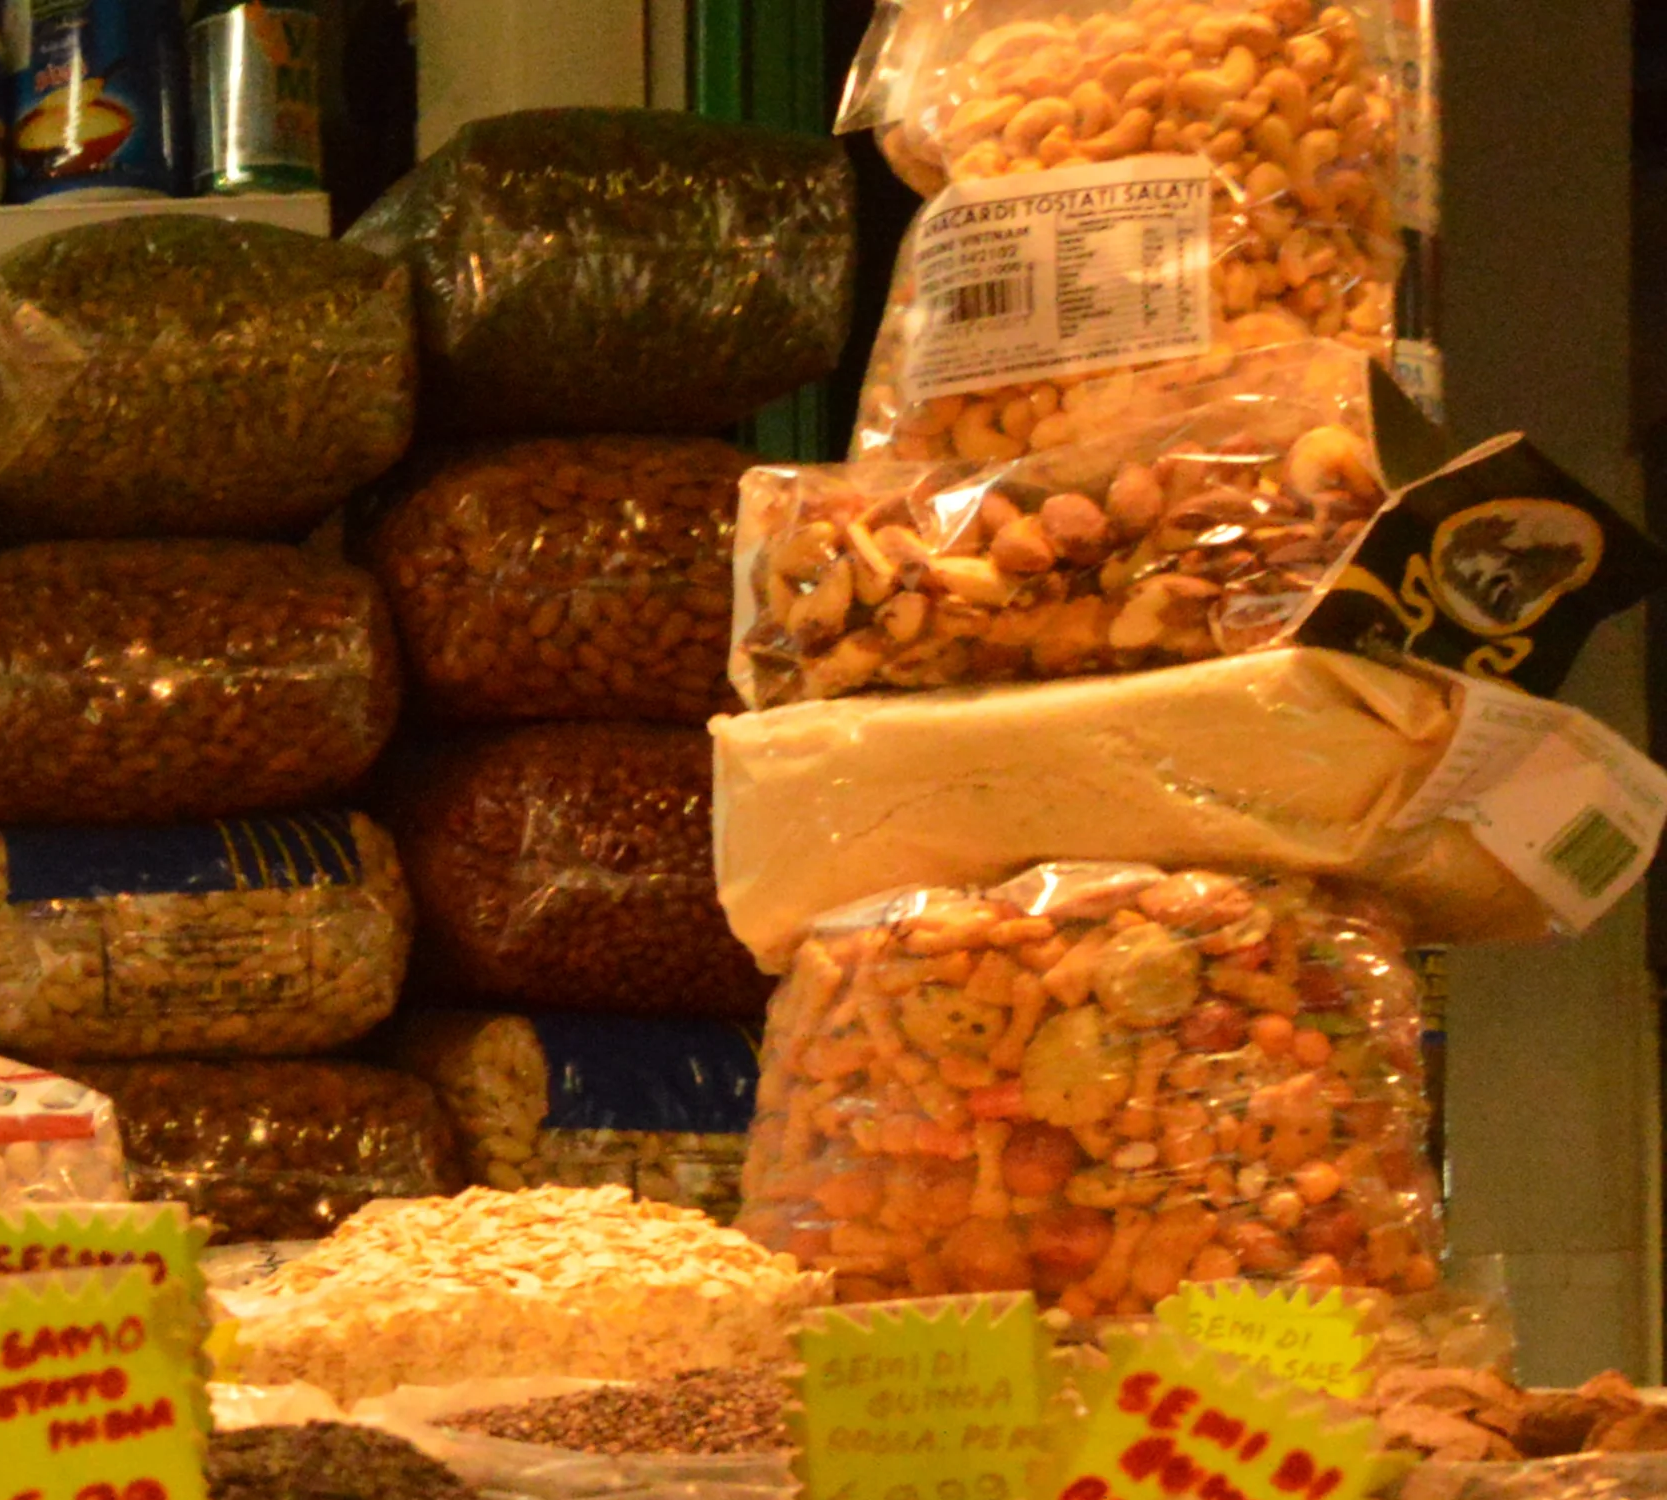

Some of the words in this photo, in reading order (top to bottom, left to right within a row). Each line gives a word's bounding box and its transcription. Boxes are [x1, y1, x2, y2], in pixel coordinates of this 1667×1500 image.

[1024, 186, 1117, 217] TOSTATI
[1122, 181, 1205, 202] SALATI
[1186, 1311, 1267, 1343] SEMI
[1274, 1327, 1313, 1352] DI
